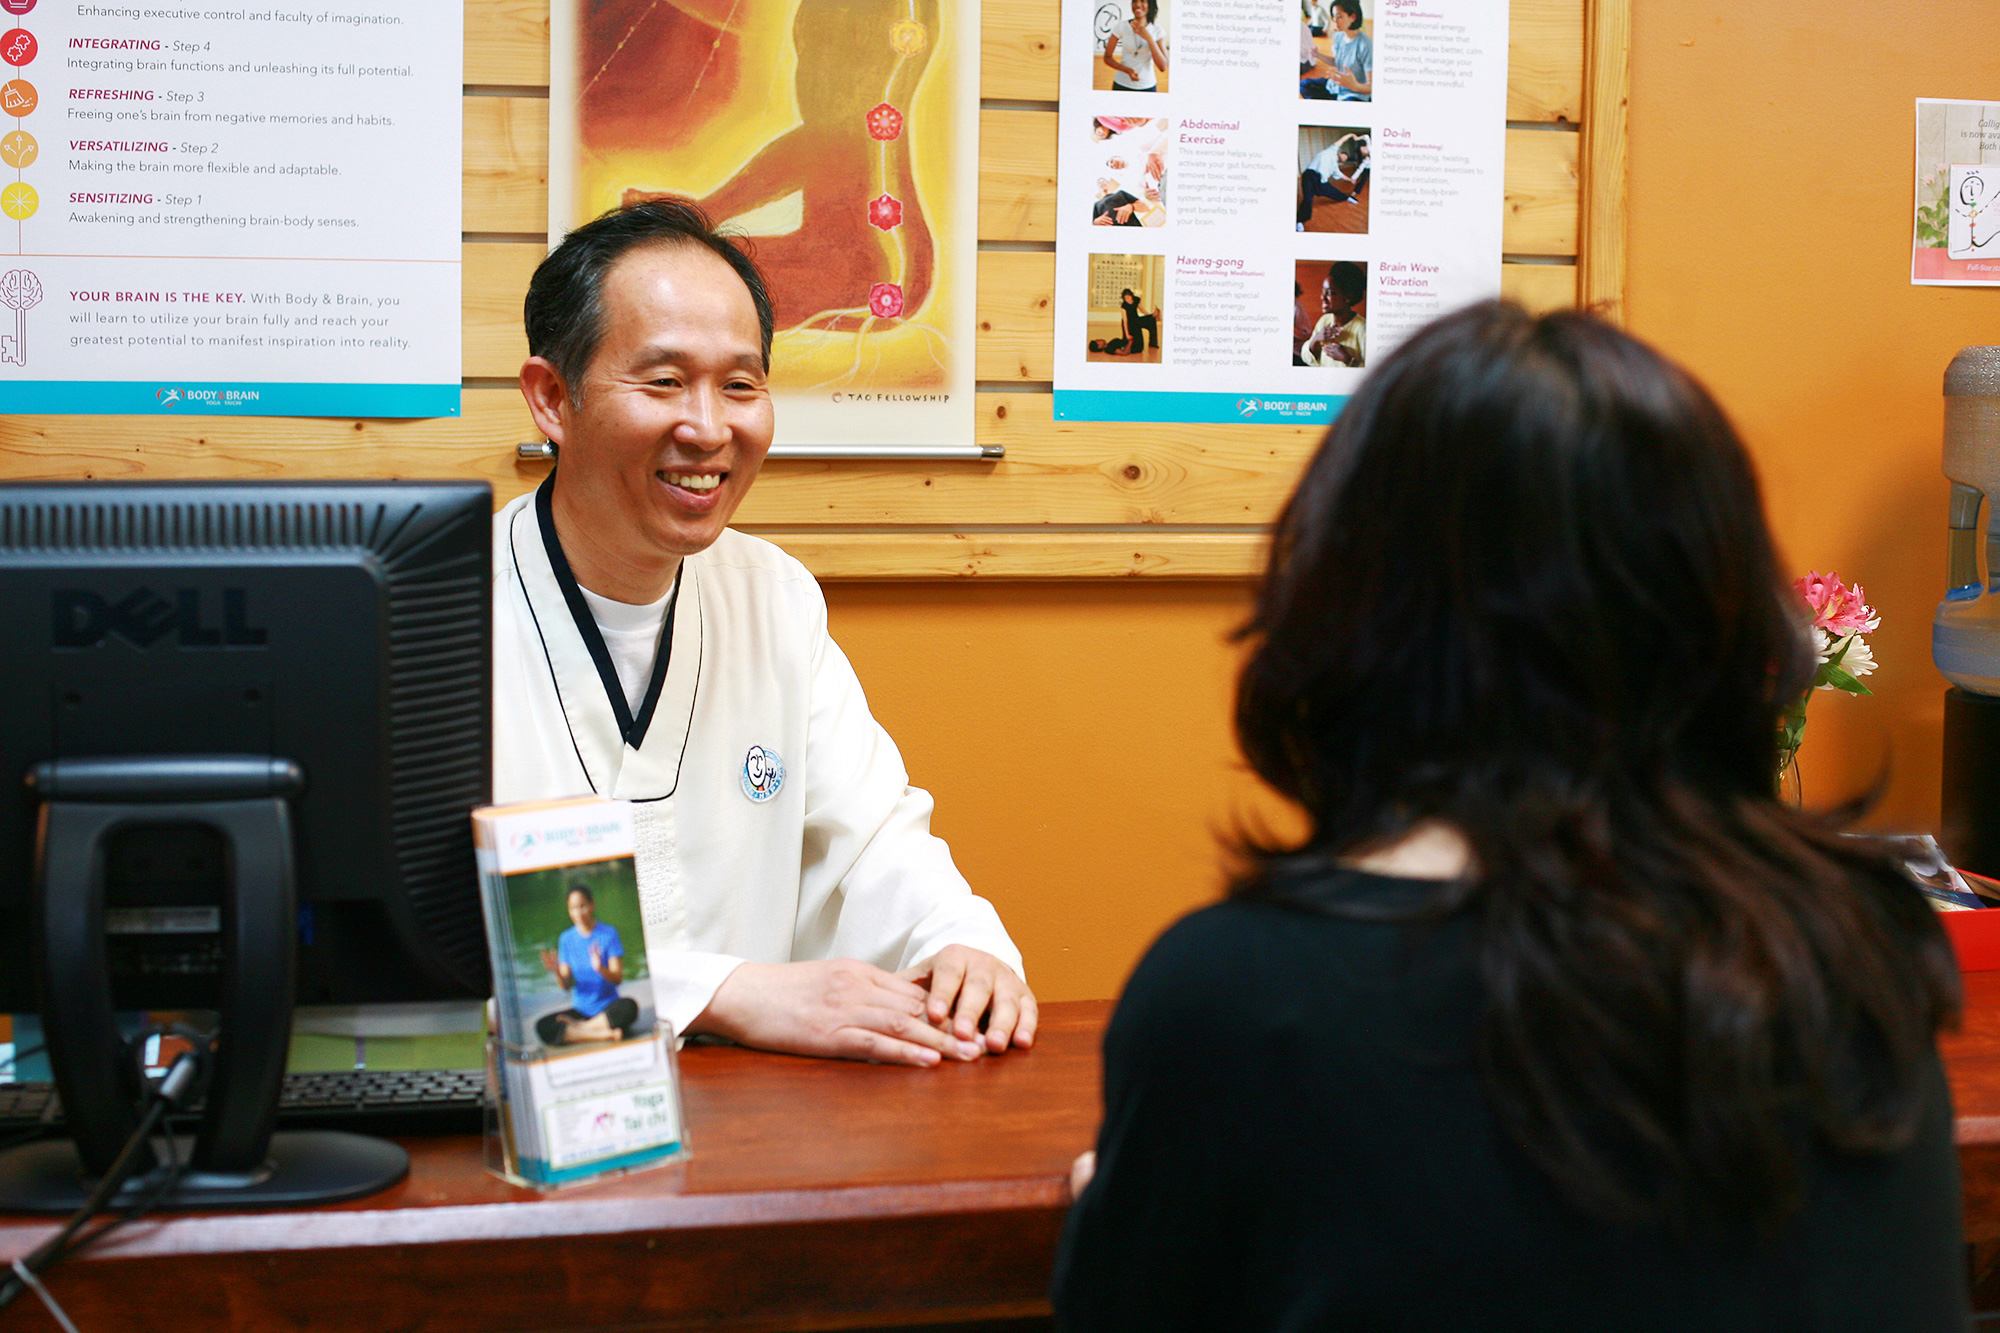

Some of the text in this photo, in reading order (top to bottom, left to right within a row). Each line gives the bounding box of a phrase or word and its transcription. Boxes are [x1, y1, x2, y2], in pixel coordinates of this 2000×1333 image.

[77, 4, 403, 26] Enhancing executive control and faculty of imagination.
[68, 38, 160, 50] INTEGRATING
[173, 40, 200, 53] Step
[203, 40, 210, 51] 4
[67, 57, 413, 77] Integrating brain functions and unleashing its full potential.
[68, 89, 154, 101] REFRESHING
[166, 91, 193, 104] Step
[197, 92, 204, 101] 3
[67, 108, 113, 122] Freeing
[150, 109, 181, 121] brain
[184, 110, 212, 122] from
[215, 112, 266, 125] negative
[269, 114, 328, 124] memories
[331, 114, 353, 125] and
[357, 114, 395, 126] habits.
[1180, 120, 1240, 130] Abdominal
[1180, 134, 1225, 144] Exercise
[1383, 128, 1411, 138] Do-in
[1960, 130, 1967, 138] is
[69, 140, 168, 152] VERSATILIZING
[180, 142, 207, 155] Step
[211, 143, 218, 153] 2
[1979, 141, 1997, 150] Both
[69, 159, 341, 177] Making the brain more flexible and adaptable.
[69, 192, 153, 204] SENSITIZING
[165, 194, 192, 207] Step
[197, 194, 202, 204] 1
[68, 212, 359, 229] Awakening and strengthening brain-body senses.
[1177, 256, 1244, 269] Haeng-gong
[1380, 262, 1439, 272] Brain Wave
[1380, 277, 1429, 286] Vibration
[69, 291, 399, 307] YOUR BRAIN IS THE KEY. With Body & Brain, you
[69, 312, 389, 329] will learn to utilize your brain fully and reach your
[70, 334, 411, 350] greatest potential to manifest inspiration into reality.
[187, 390, 260, 400] BODY&BRAIN
[848, 393, 950, 403] TAO FELLOWSHIP
[1264, 401, 1327, 411] BODY&BRAIN
[51, 588, 268, 653] DELL
